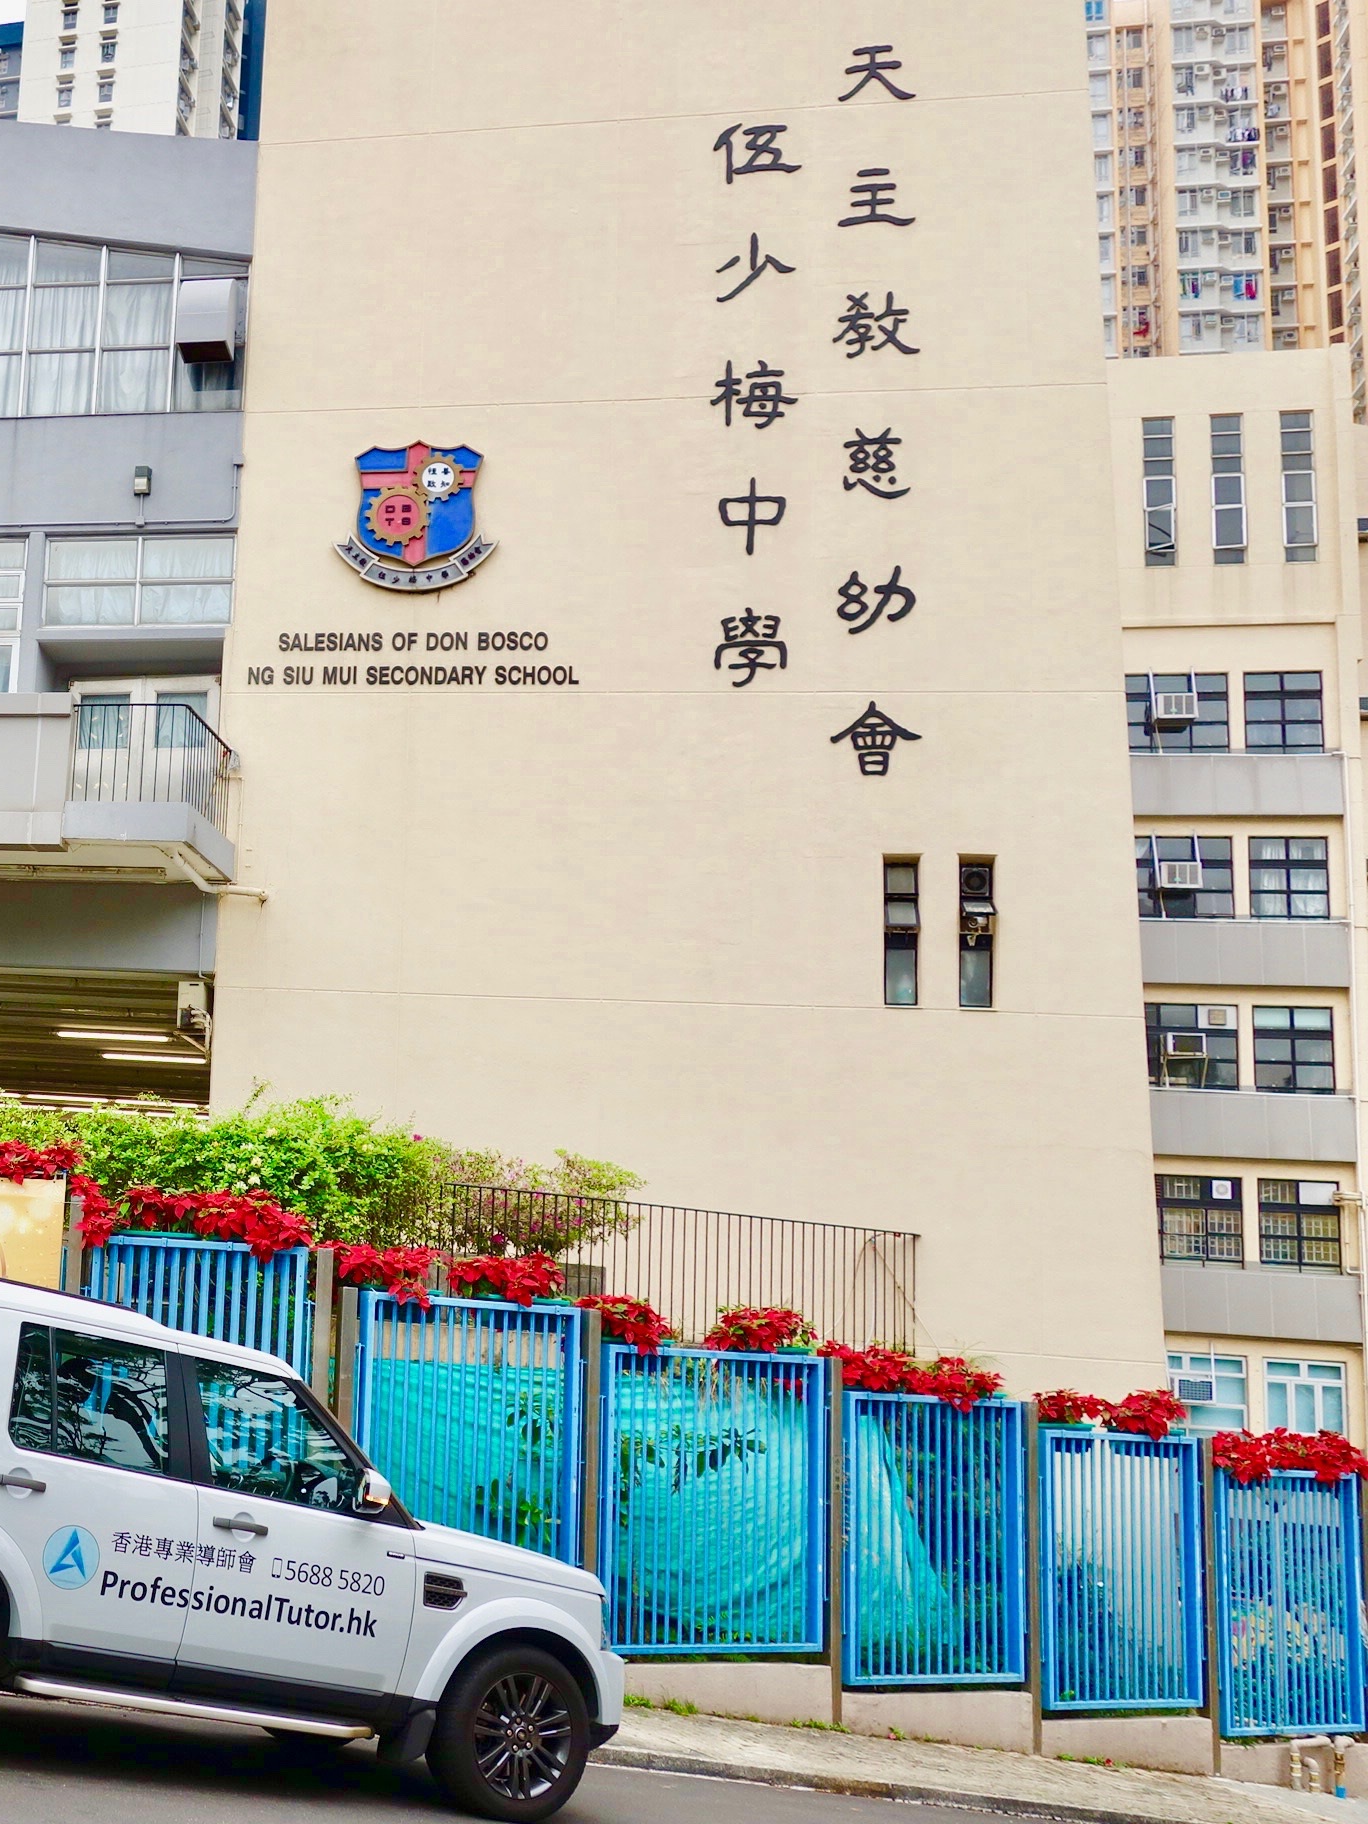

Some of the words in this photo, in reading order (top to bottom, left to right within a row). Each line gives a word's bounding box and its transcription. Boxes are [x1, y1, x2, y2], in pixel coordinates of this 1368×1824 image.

[711, 122, 802, 688] 伍少梅中學
[831, 45, 922, 777] 天主教慈幼會
[278, 631, 383, 652] SALESIANS
[392, 631, 419, 651] OF
[425, 630, 468, 651] DON
[477, 630, 549, 651] BOSCO
[247, 665, 274, 686] NG
[283, 665, 313, 686] SIU
[322, 665, 357, 685] MUI
[366, 665, 487, 685] SECONDARY
[494, 665, 580, 685] SCHOOL
[111, 1531, 257, 1575] 香港專業導師會
[284, 1559, 333, 1588] 5688
[337, 1568, 386, 1597] 5820
[100, 1570, 378, 1639] ProfessionalTutor.hk
